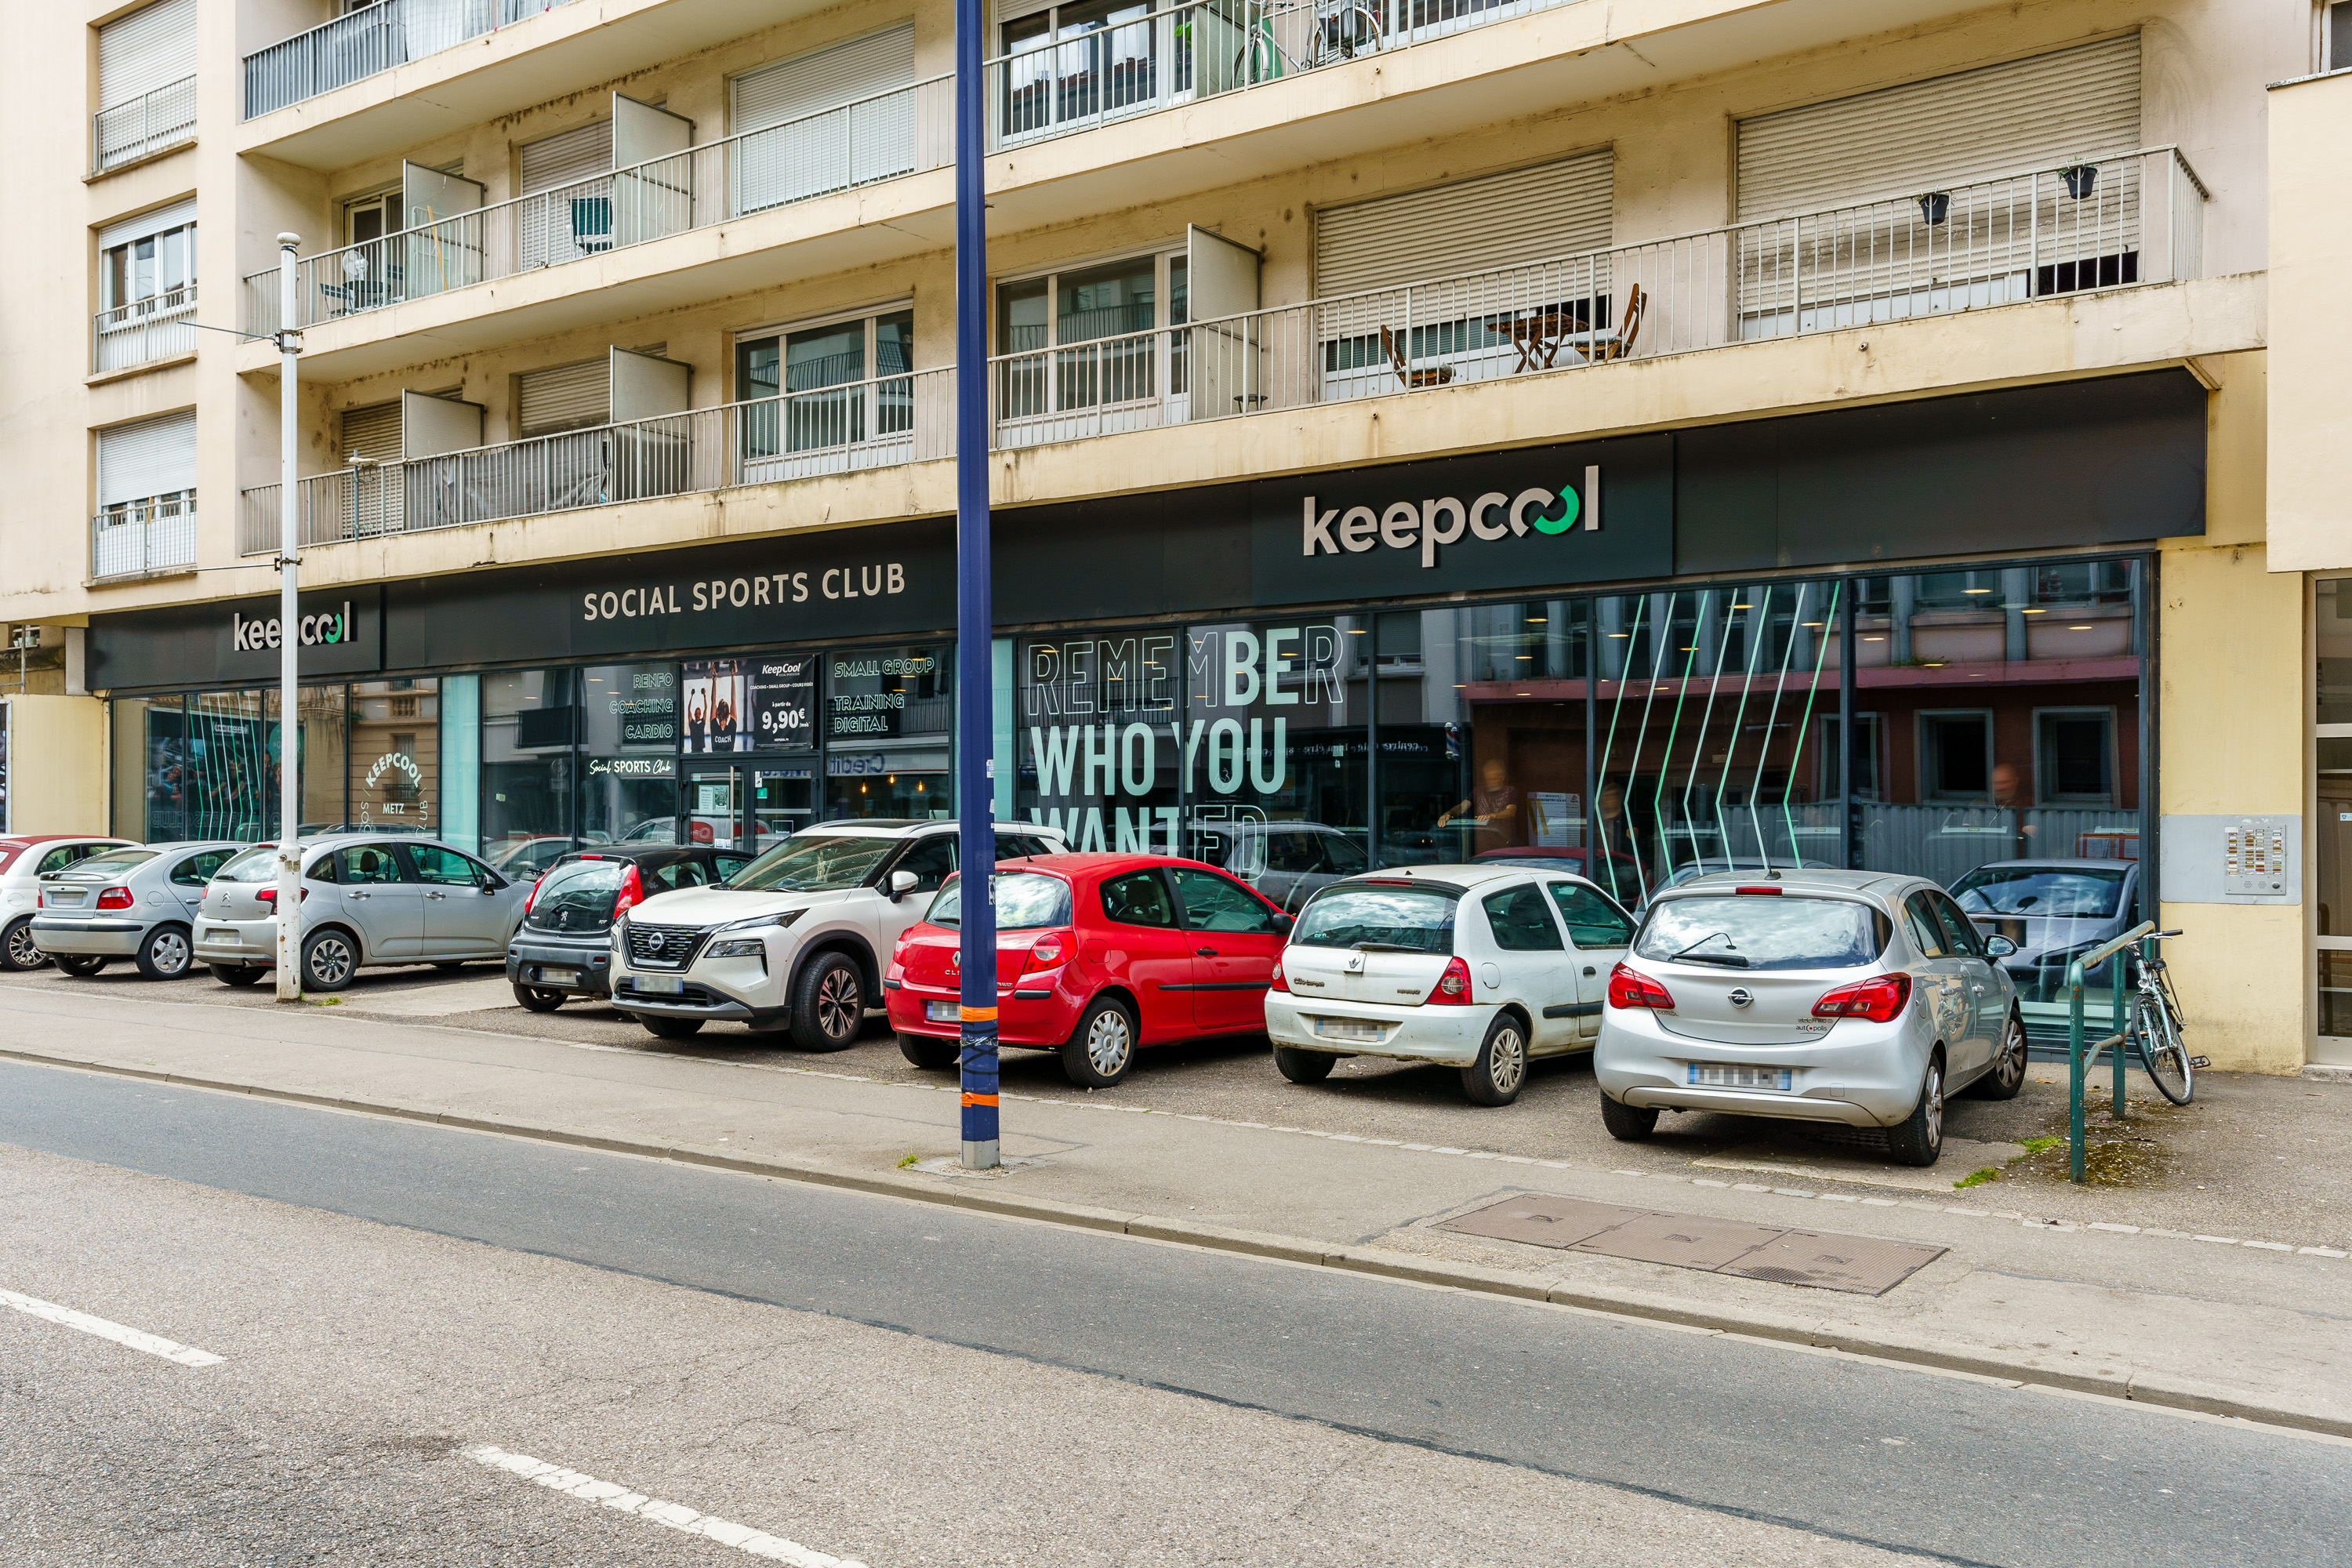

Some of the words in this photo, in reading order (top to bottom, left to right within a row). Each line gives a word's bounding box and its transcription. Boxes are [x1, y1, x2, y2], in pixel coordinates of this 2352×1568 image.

[1303, 465, 1599, 568] keepcool
[584, 585, 681, 621] SOCIAL
[693, 572, 808, 612] SPORTS
[822, 563, 906, 600] CLUB
[234, 601, 350, 652] keecool
[834, 660, 880, 678] SMALL
[882, 657, 935, 675] GROUP
[1028, 625, 1343, 715] REMEMBER
[633, 672, 673, 688] RENFO
[608, 698, 673, 714] COACHING
[834, 693, 905, 710] TRAINING
[625, 724, 673, 739] CARDIO
[834, 716, 888, 732] DIGITAL
[714, 735, 731, 743] COACH
[1029, 721, 1155, 797] WHO
[1171, 717, 1287, 794] YOU
[365, 752, 423, 789] KEEPCOOL
[589, 759, 612, 775] Social
[614, 760, 652, 773] SPORTS
[652, 759, 672, 774] Club
[382, 803, 405, 815] METZ
